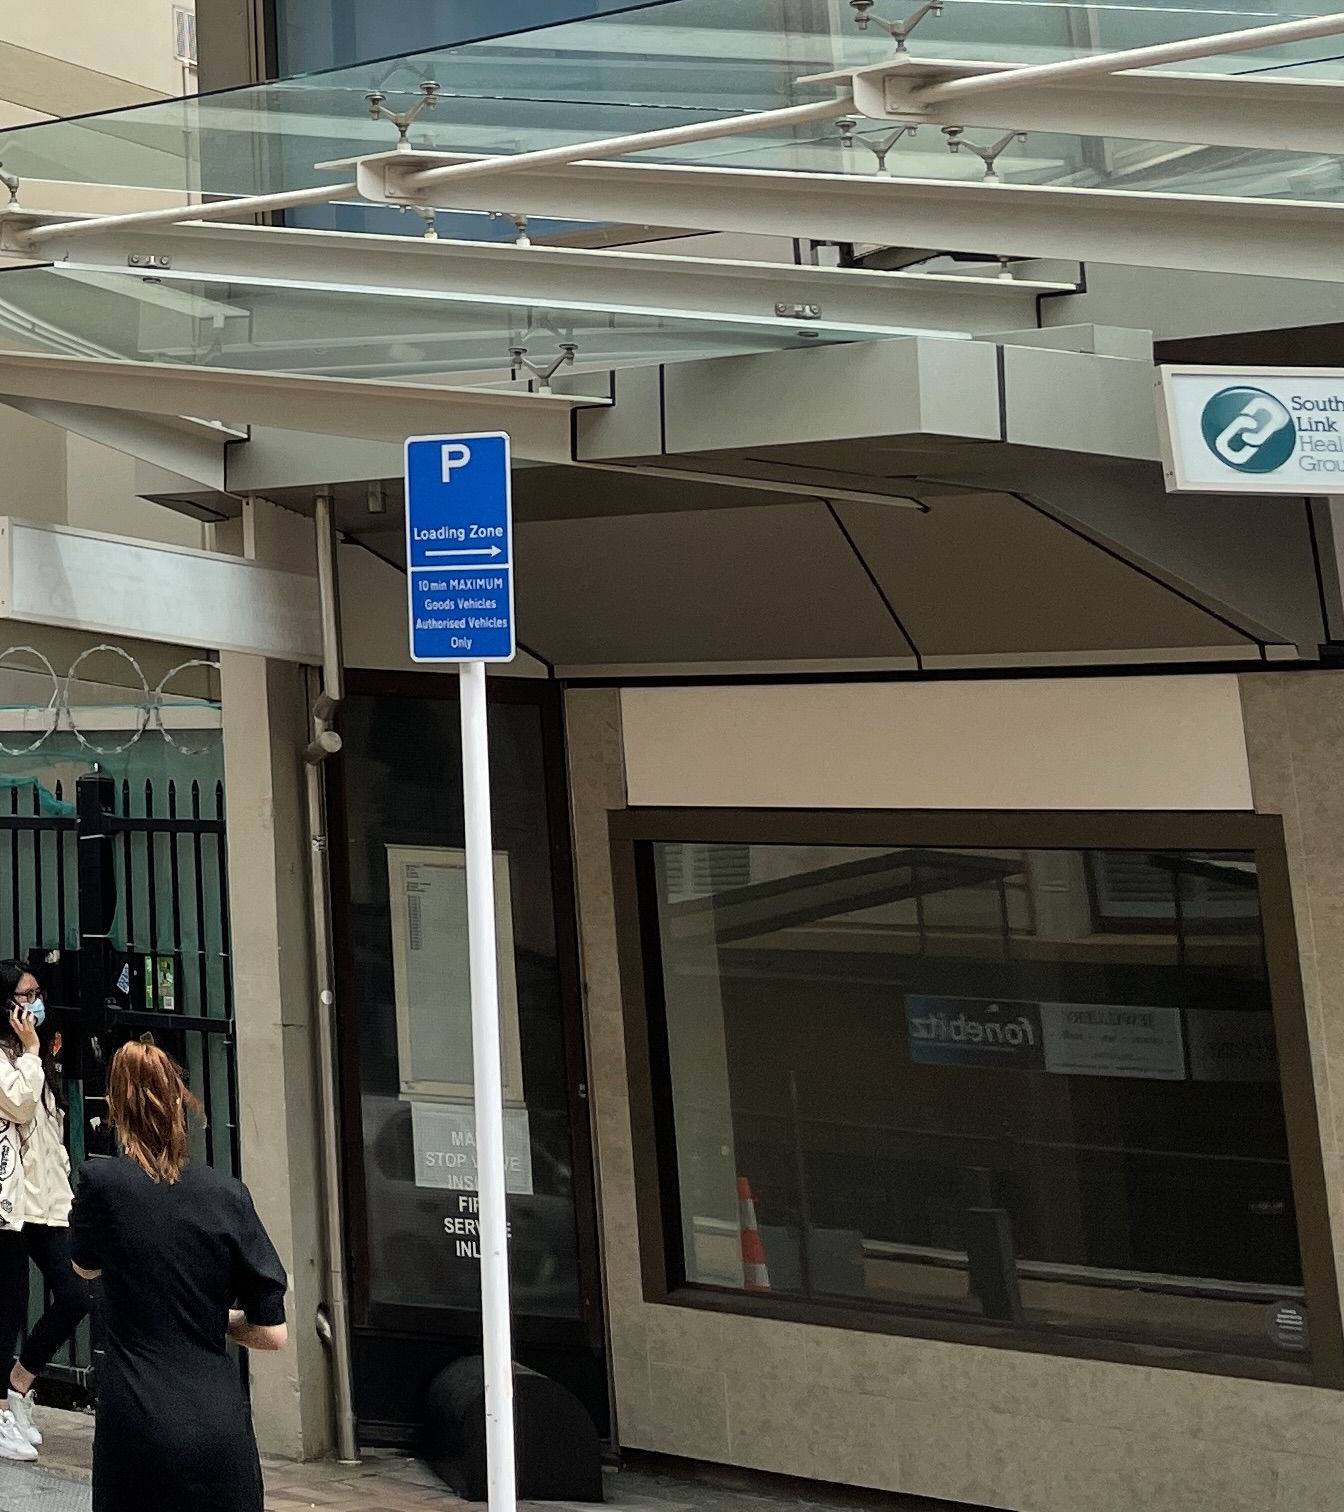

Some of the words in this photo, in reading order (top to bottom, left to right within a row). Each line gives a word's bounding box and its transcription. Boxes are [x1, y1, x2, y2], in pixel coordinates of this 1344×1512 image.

[1291, 395, 1344, 412] South
[1296, 416, 1338, 432] Link
[1299, 435, 1344, 452] Heal
[441, 444, 471, 483] P
[1299, 455, 1344, 472] Grou
[414, 526, 466, 542] Loading
[469, 524, 503, 538] Zone
[418, 580, 429, 591] 10
[430, 579, 447, 591] min
[449, 578, 503, 590] MAXIMUM
[424, 598, 455, 611] Goods
[458, 597, 497, 609] Vehicles
[415, 616, 466, 630] Authorised
[468, 614, 508, 628] Vehicles
[450, 635, 473, 650] Only
[425, 1152, 467, 1168] STOP
